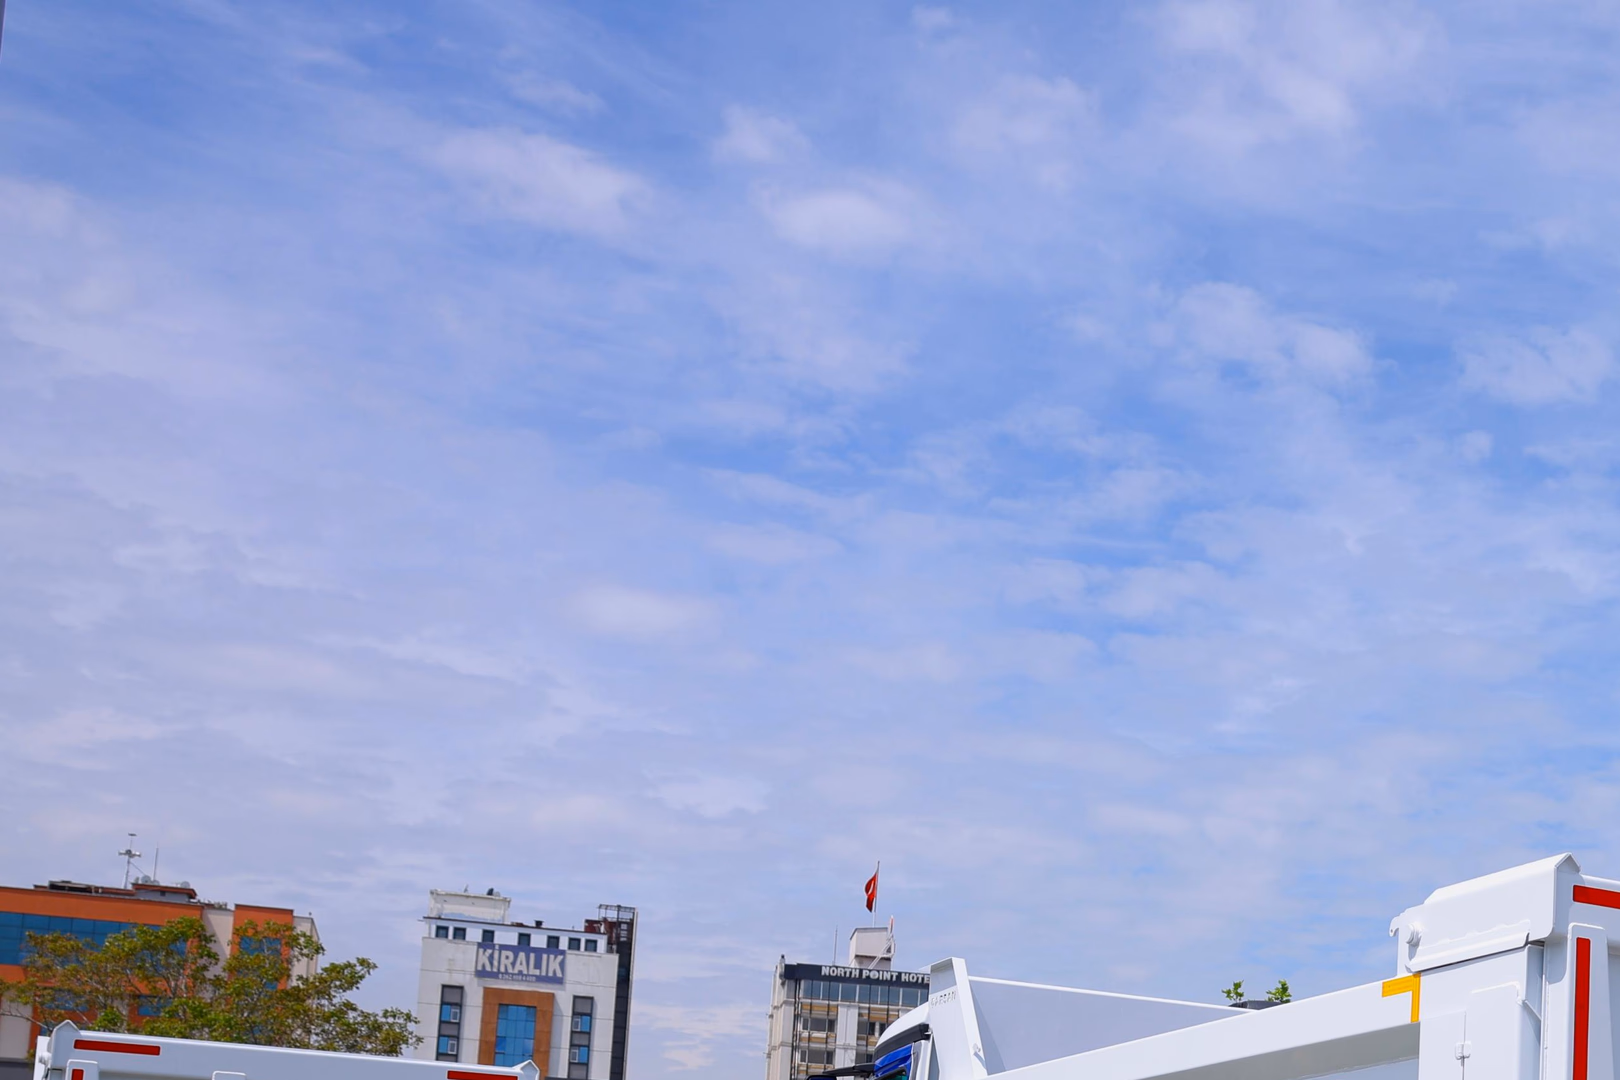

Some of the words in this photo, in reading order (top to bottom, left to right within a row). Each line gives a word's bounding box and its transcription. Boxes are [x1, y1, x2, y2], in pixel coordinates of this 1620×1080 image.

[477, 944, 564, 977] KİRALIK
[821, 966, 859, 978] NORTH
[862, 970, 898, 981] POINT
